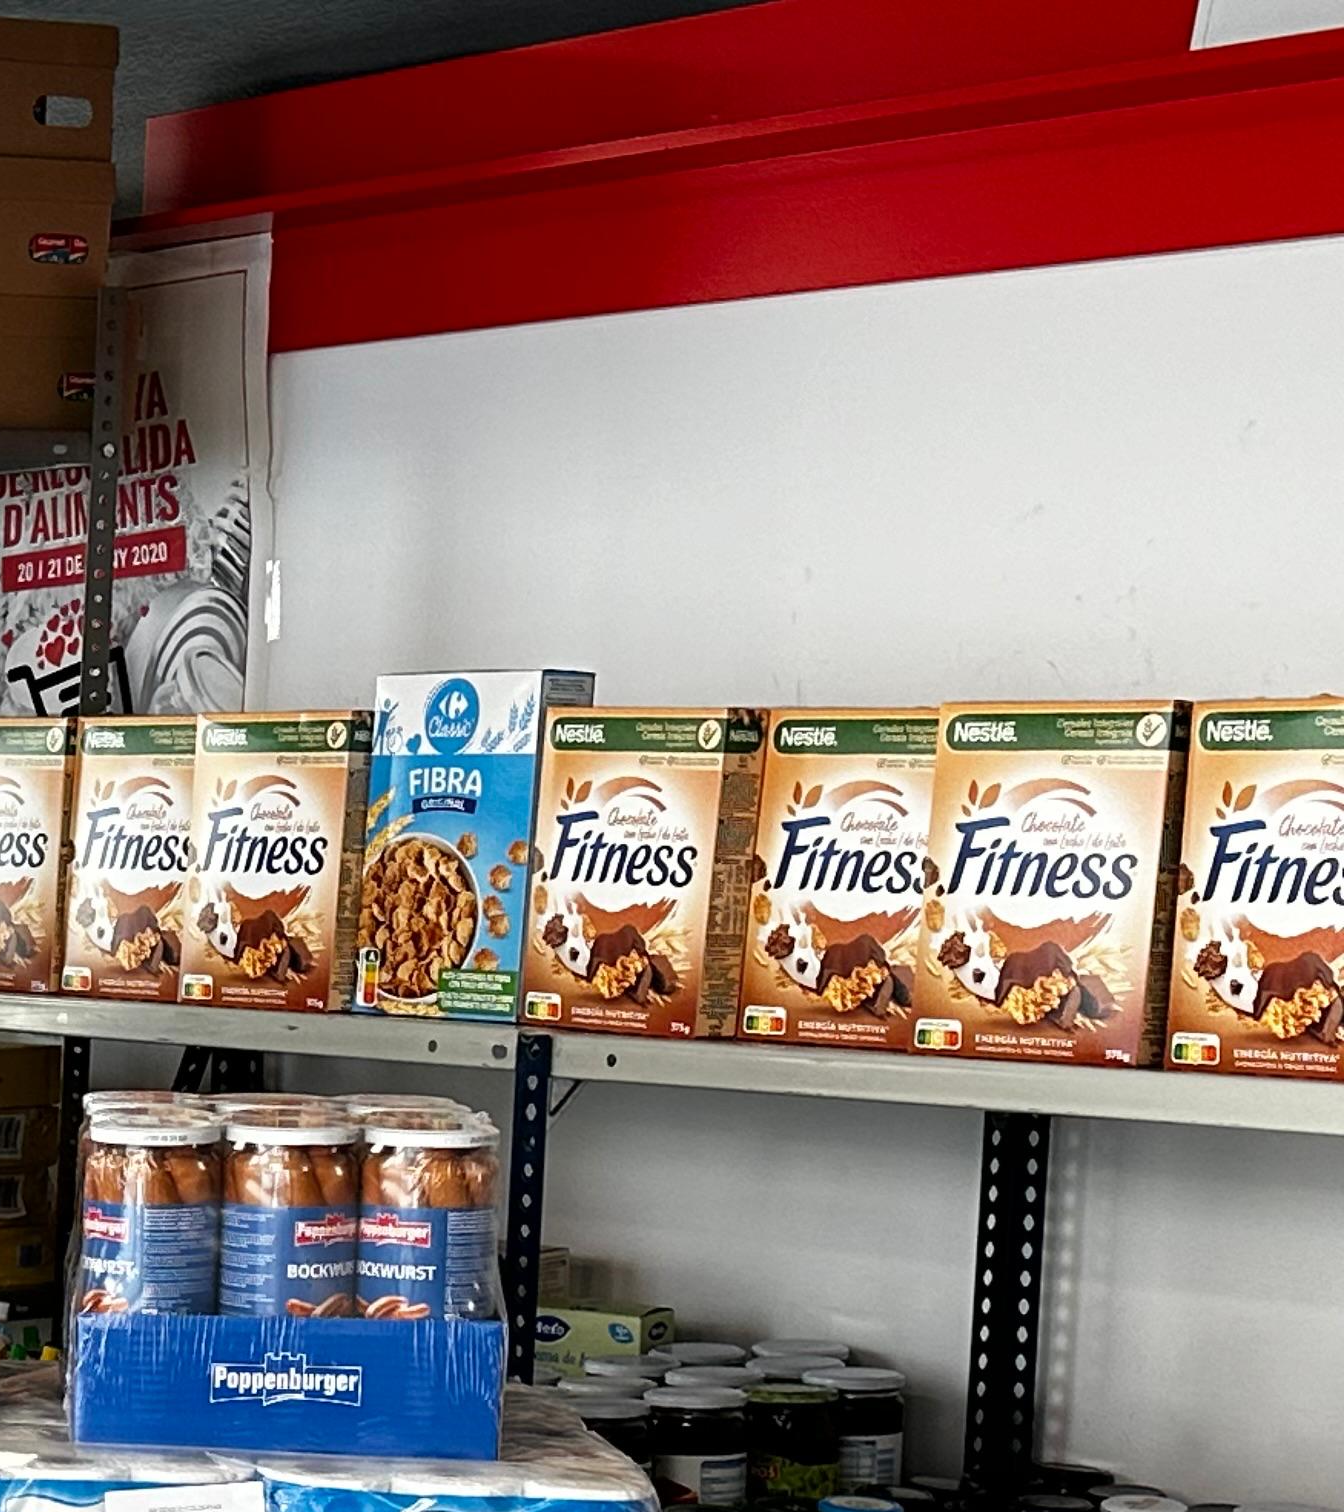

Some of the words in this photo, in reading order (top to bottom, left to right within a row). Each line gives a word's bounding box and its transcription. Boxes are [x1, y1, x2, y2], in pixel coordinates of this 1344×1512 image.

[17, 561, 33, 582] 20
[48, 557, 61, 577] 21
[66, 555, 83, 575] DE
[132, 542, 167, 566] 2020
[409, 767, 482, 796] FIBRA
[203, 807, 328, 875] Fitness
[550, 811, 698, 888] Fitness
[947, 817, 1139, 899] Fitness
[1202, 820, 1344, 905] Fitne
[214, 1366, 360, 1396] Poppenburger
